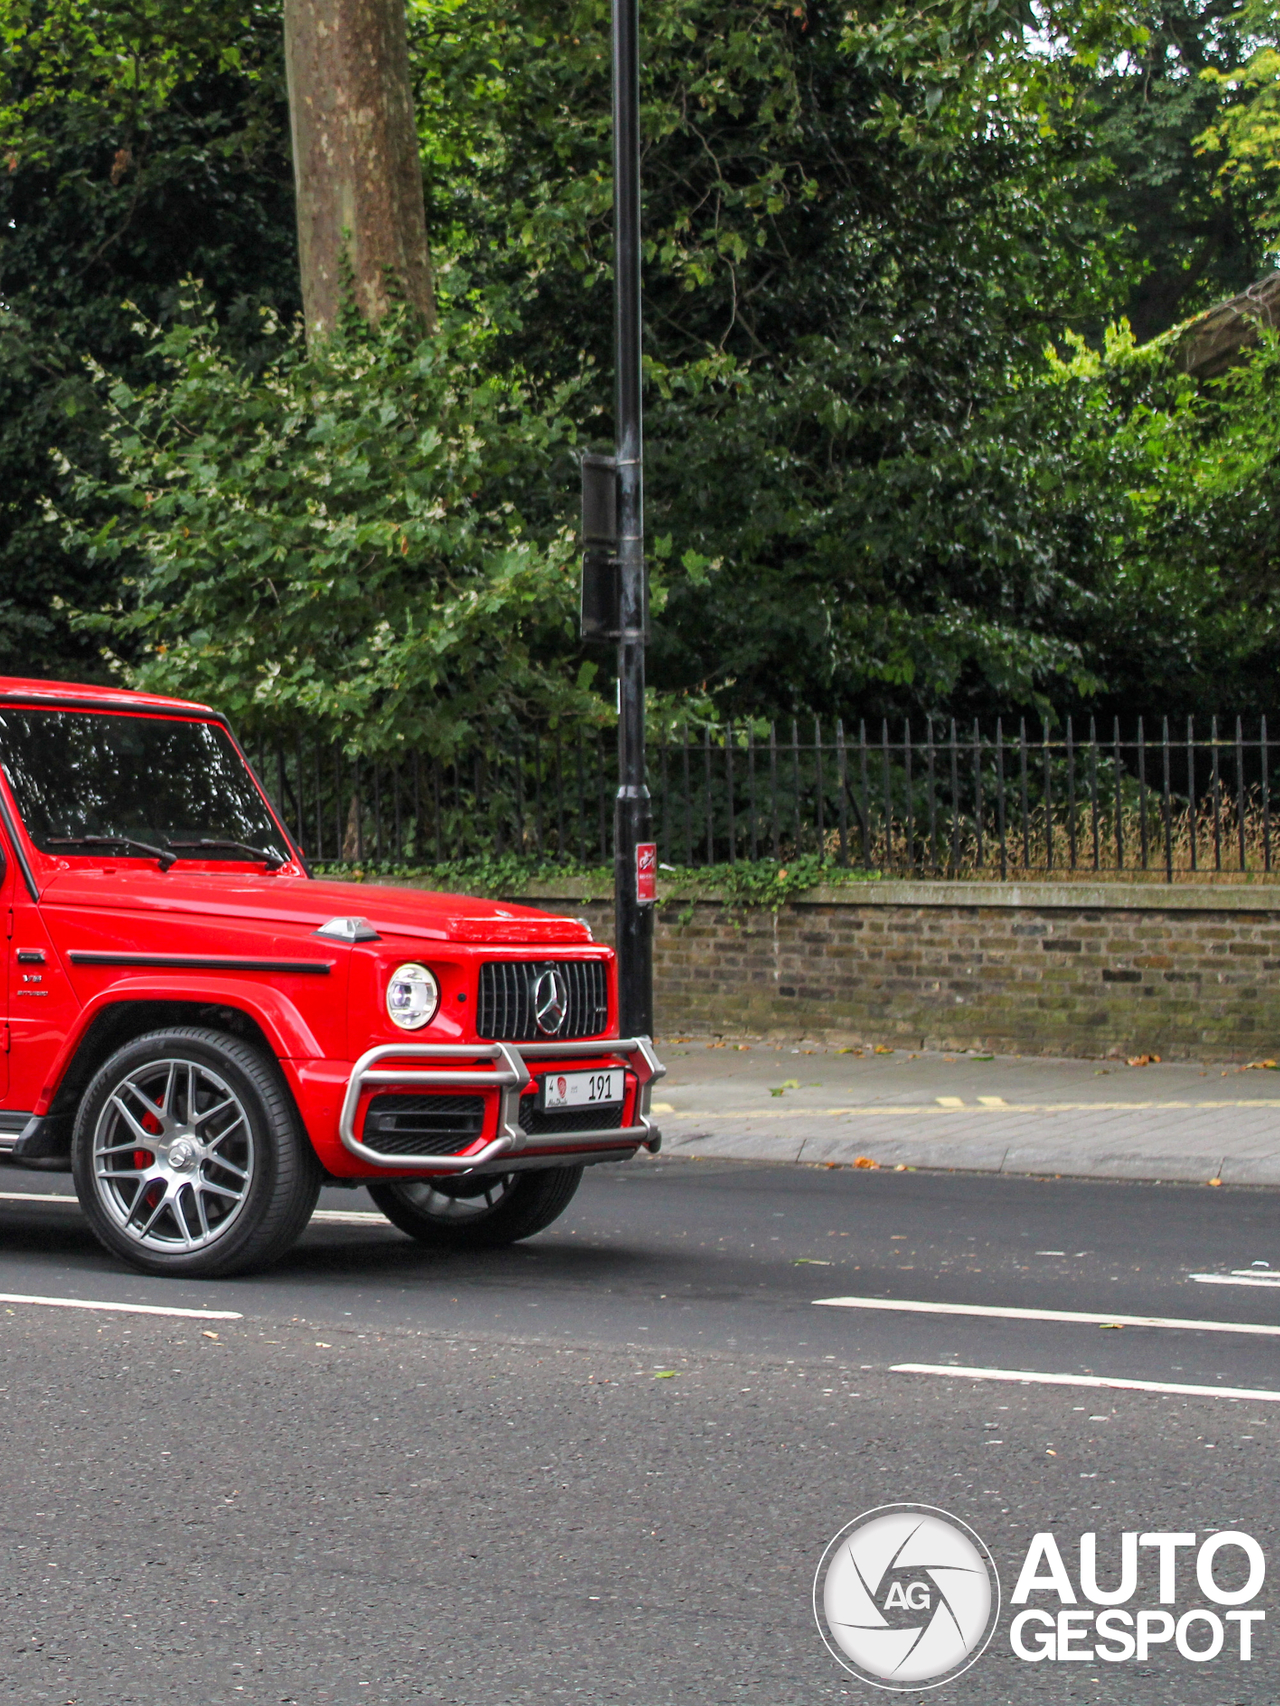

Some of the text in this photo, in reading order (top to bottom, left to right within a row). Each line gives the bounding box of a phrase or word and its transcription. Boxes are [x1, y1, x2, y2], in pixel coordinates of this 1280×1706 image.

[22, 974, 42, 983] V8
[549, 1079, 554, 1093] 4
[588, 1074, 612, 1101] 191
